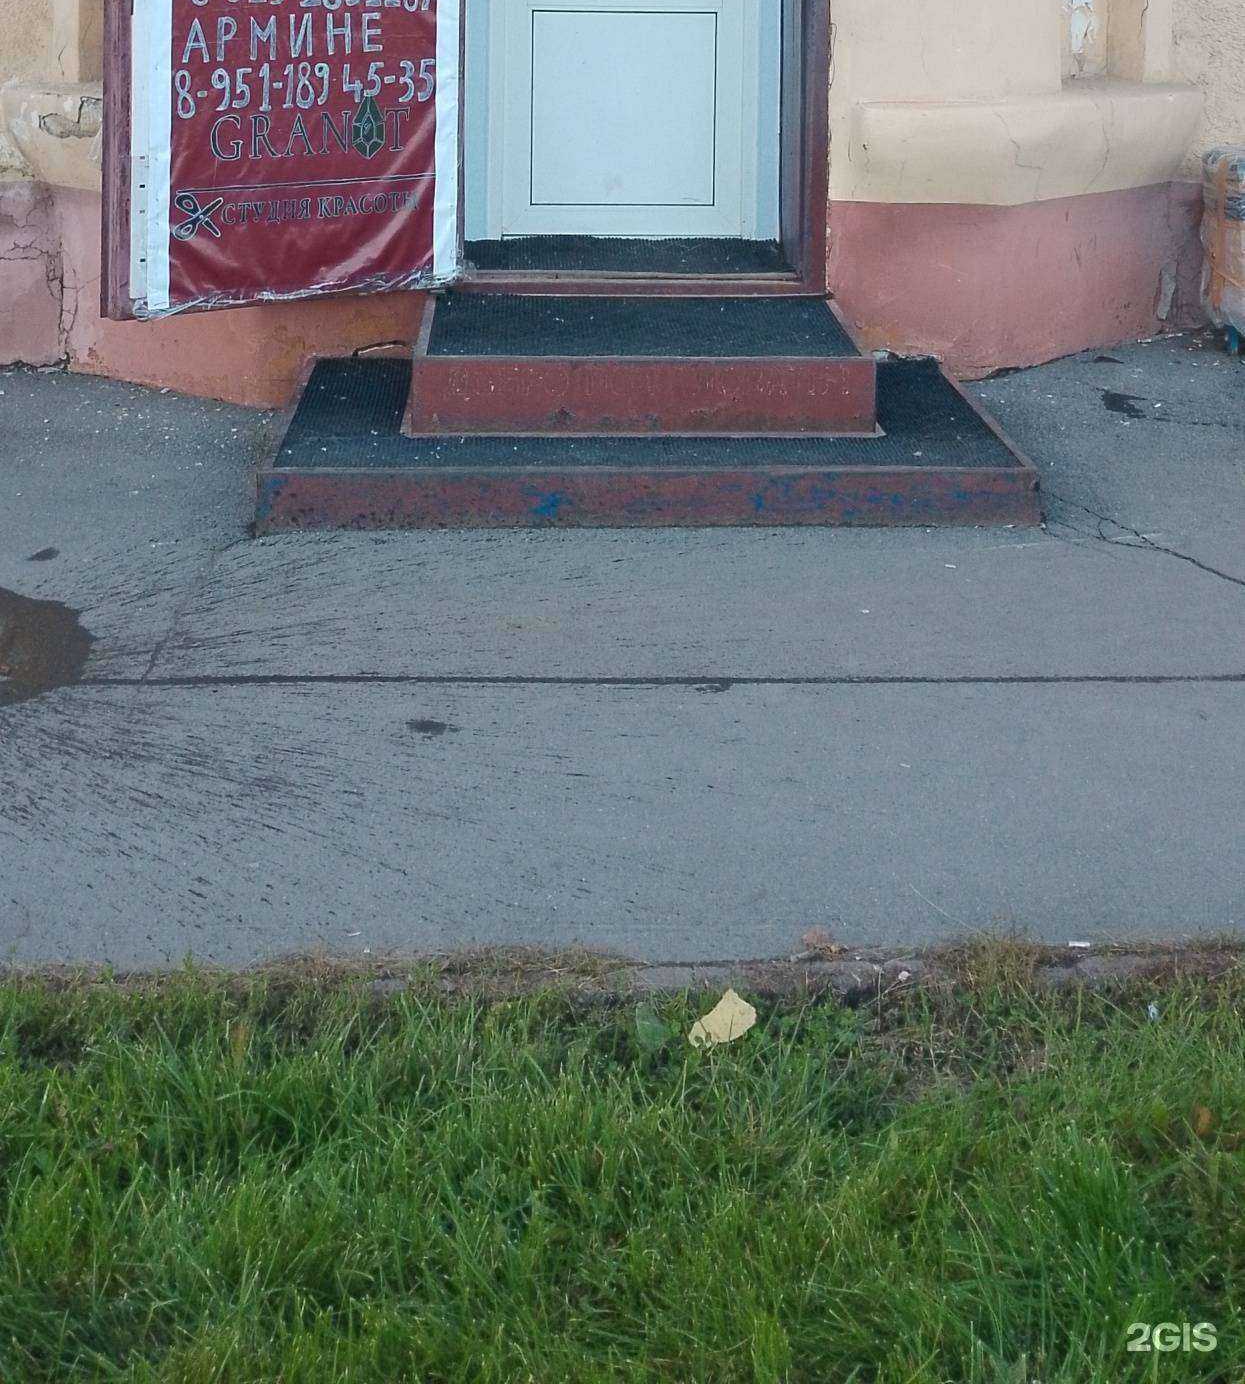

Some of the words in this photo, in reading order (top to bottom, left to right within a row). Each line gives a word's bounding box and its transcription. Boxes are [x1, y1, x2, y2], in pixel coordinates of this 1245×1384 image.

[182, 12, 384, 64] АРМИНЕ
[220, 196, 312, 225] СТУДИЯ
[317, 190, 420, 218] КРАСОТЫ
